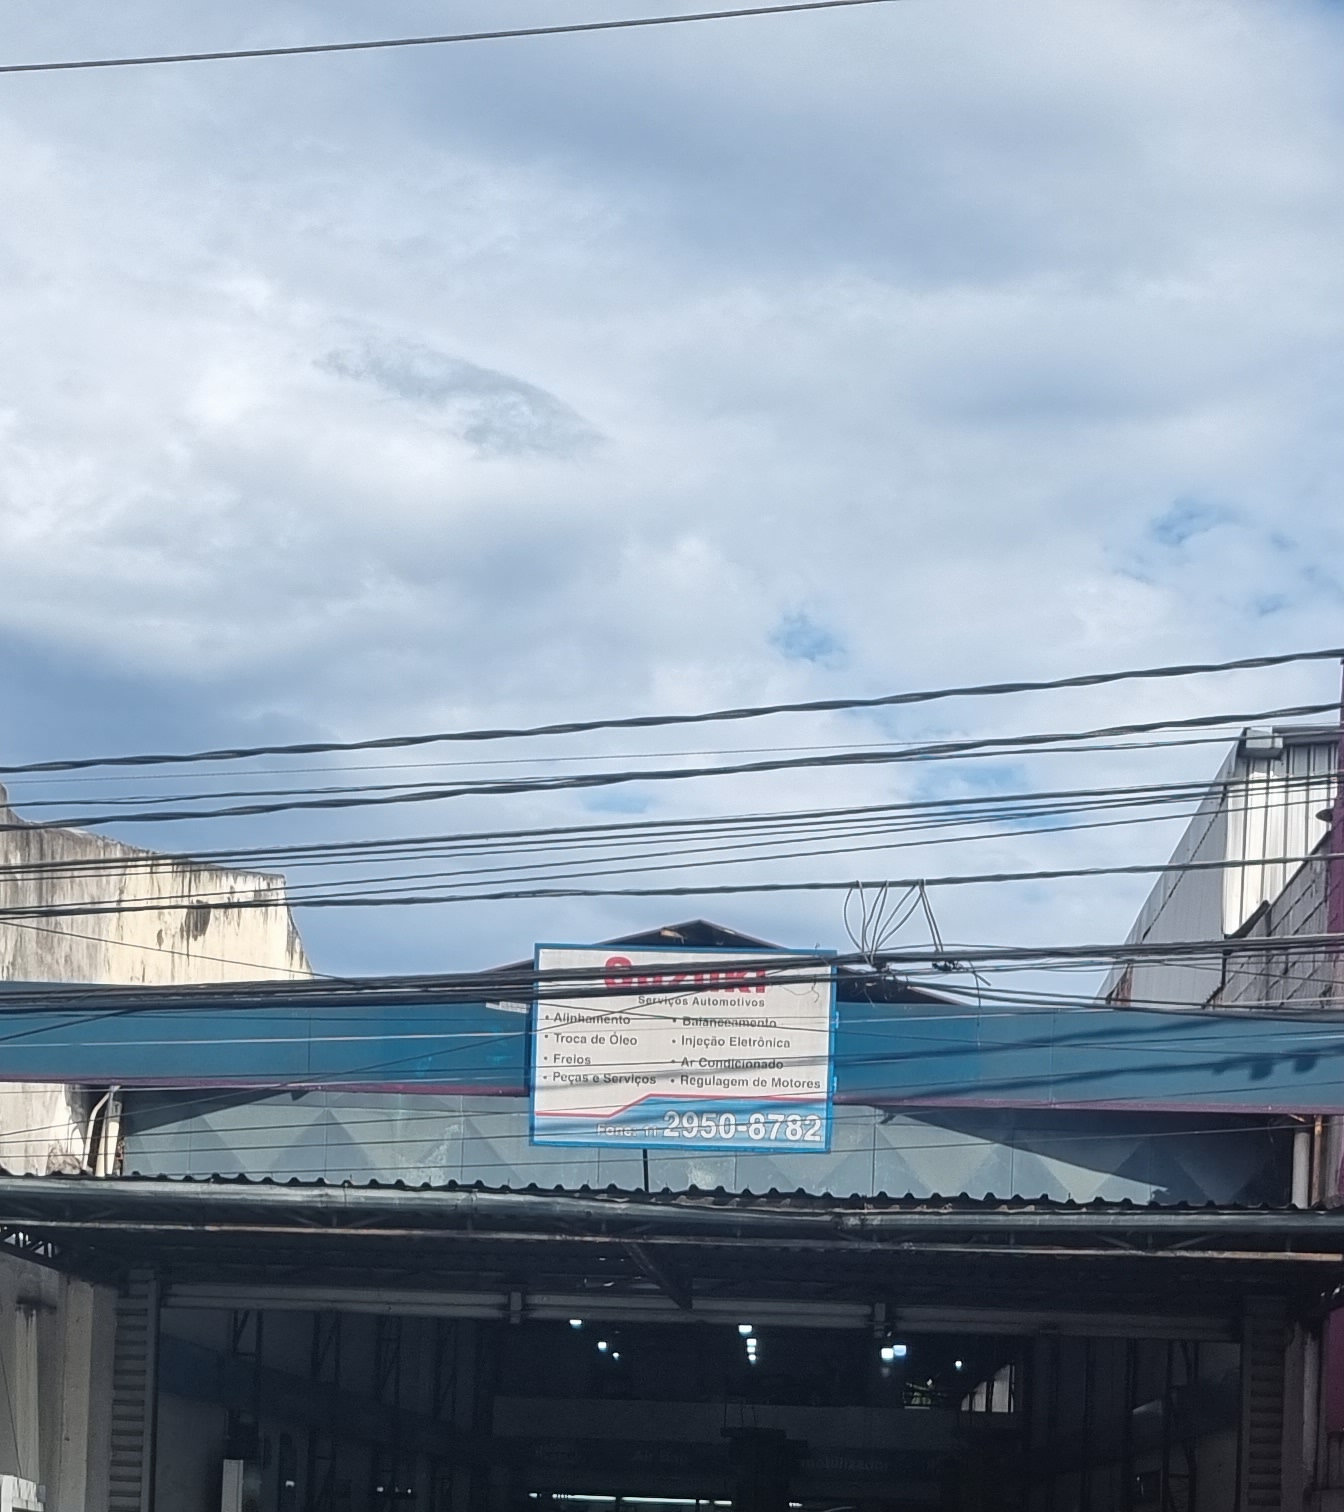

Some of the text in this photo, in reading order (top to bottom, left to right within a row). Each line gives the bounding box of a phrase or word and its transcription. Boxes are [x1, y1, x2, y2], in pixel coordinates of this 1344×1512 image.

[638, 996, 765, 1008] Serviços Automotivos
[553, 1012, 631, 1027] Alinhamento
[554, 1031, 638, 1045] Troca de Óleo
[681, 1035, 790, 1048] Injeção Eletrônica
[553, 1054, 591, 1065] Freios
[681, 1057, 784, 1069] Ar Condicionado
[552, 1071, 657, 1087] Peças e Serviços
[680, 1074, 821, 1089] Regulagem de Motores
[663, 1111, 822, 1142] 2950-8782
